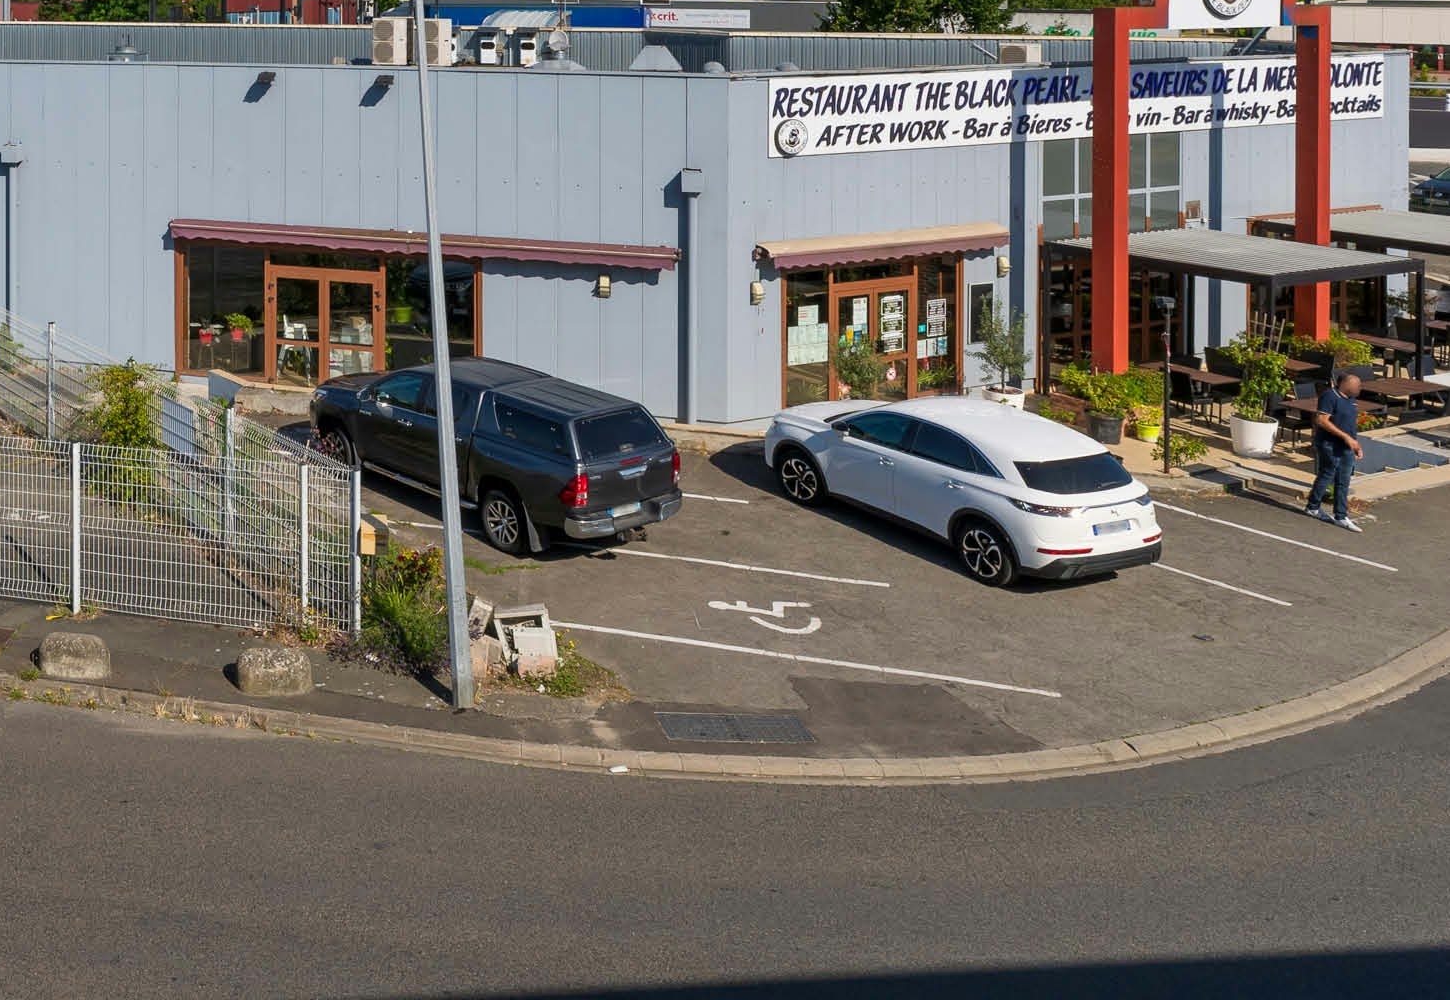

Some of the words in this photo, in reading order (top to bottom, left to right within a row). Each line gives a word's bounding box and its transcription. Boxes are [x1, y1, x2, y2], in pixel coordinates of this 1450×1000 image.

[772, 82, 911, 118] RESTAURANT
[915, 80, 953, 111] THE
[953, 78, 1019, 111] BLACK
[1130, 68, 1208, 99] SAVEURS
[1212, 68, 1235, 95] DE
[1237, 66, 1258, 94] LA
[1263, 65, 1296, 92] MER
[815, 121, 889, 147] AFTER
[889, 119, 949, 143] WORK
[963, 118, 996, 139] Bar
[1016, 113, 1073, 135] Bieres
